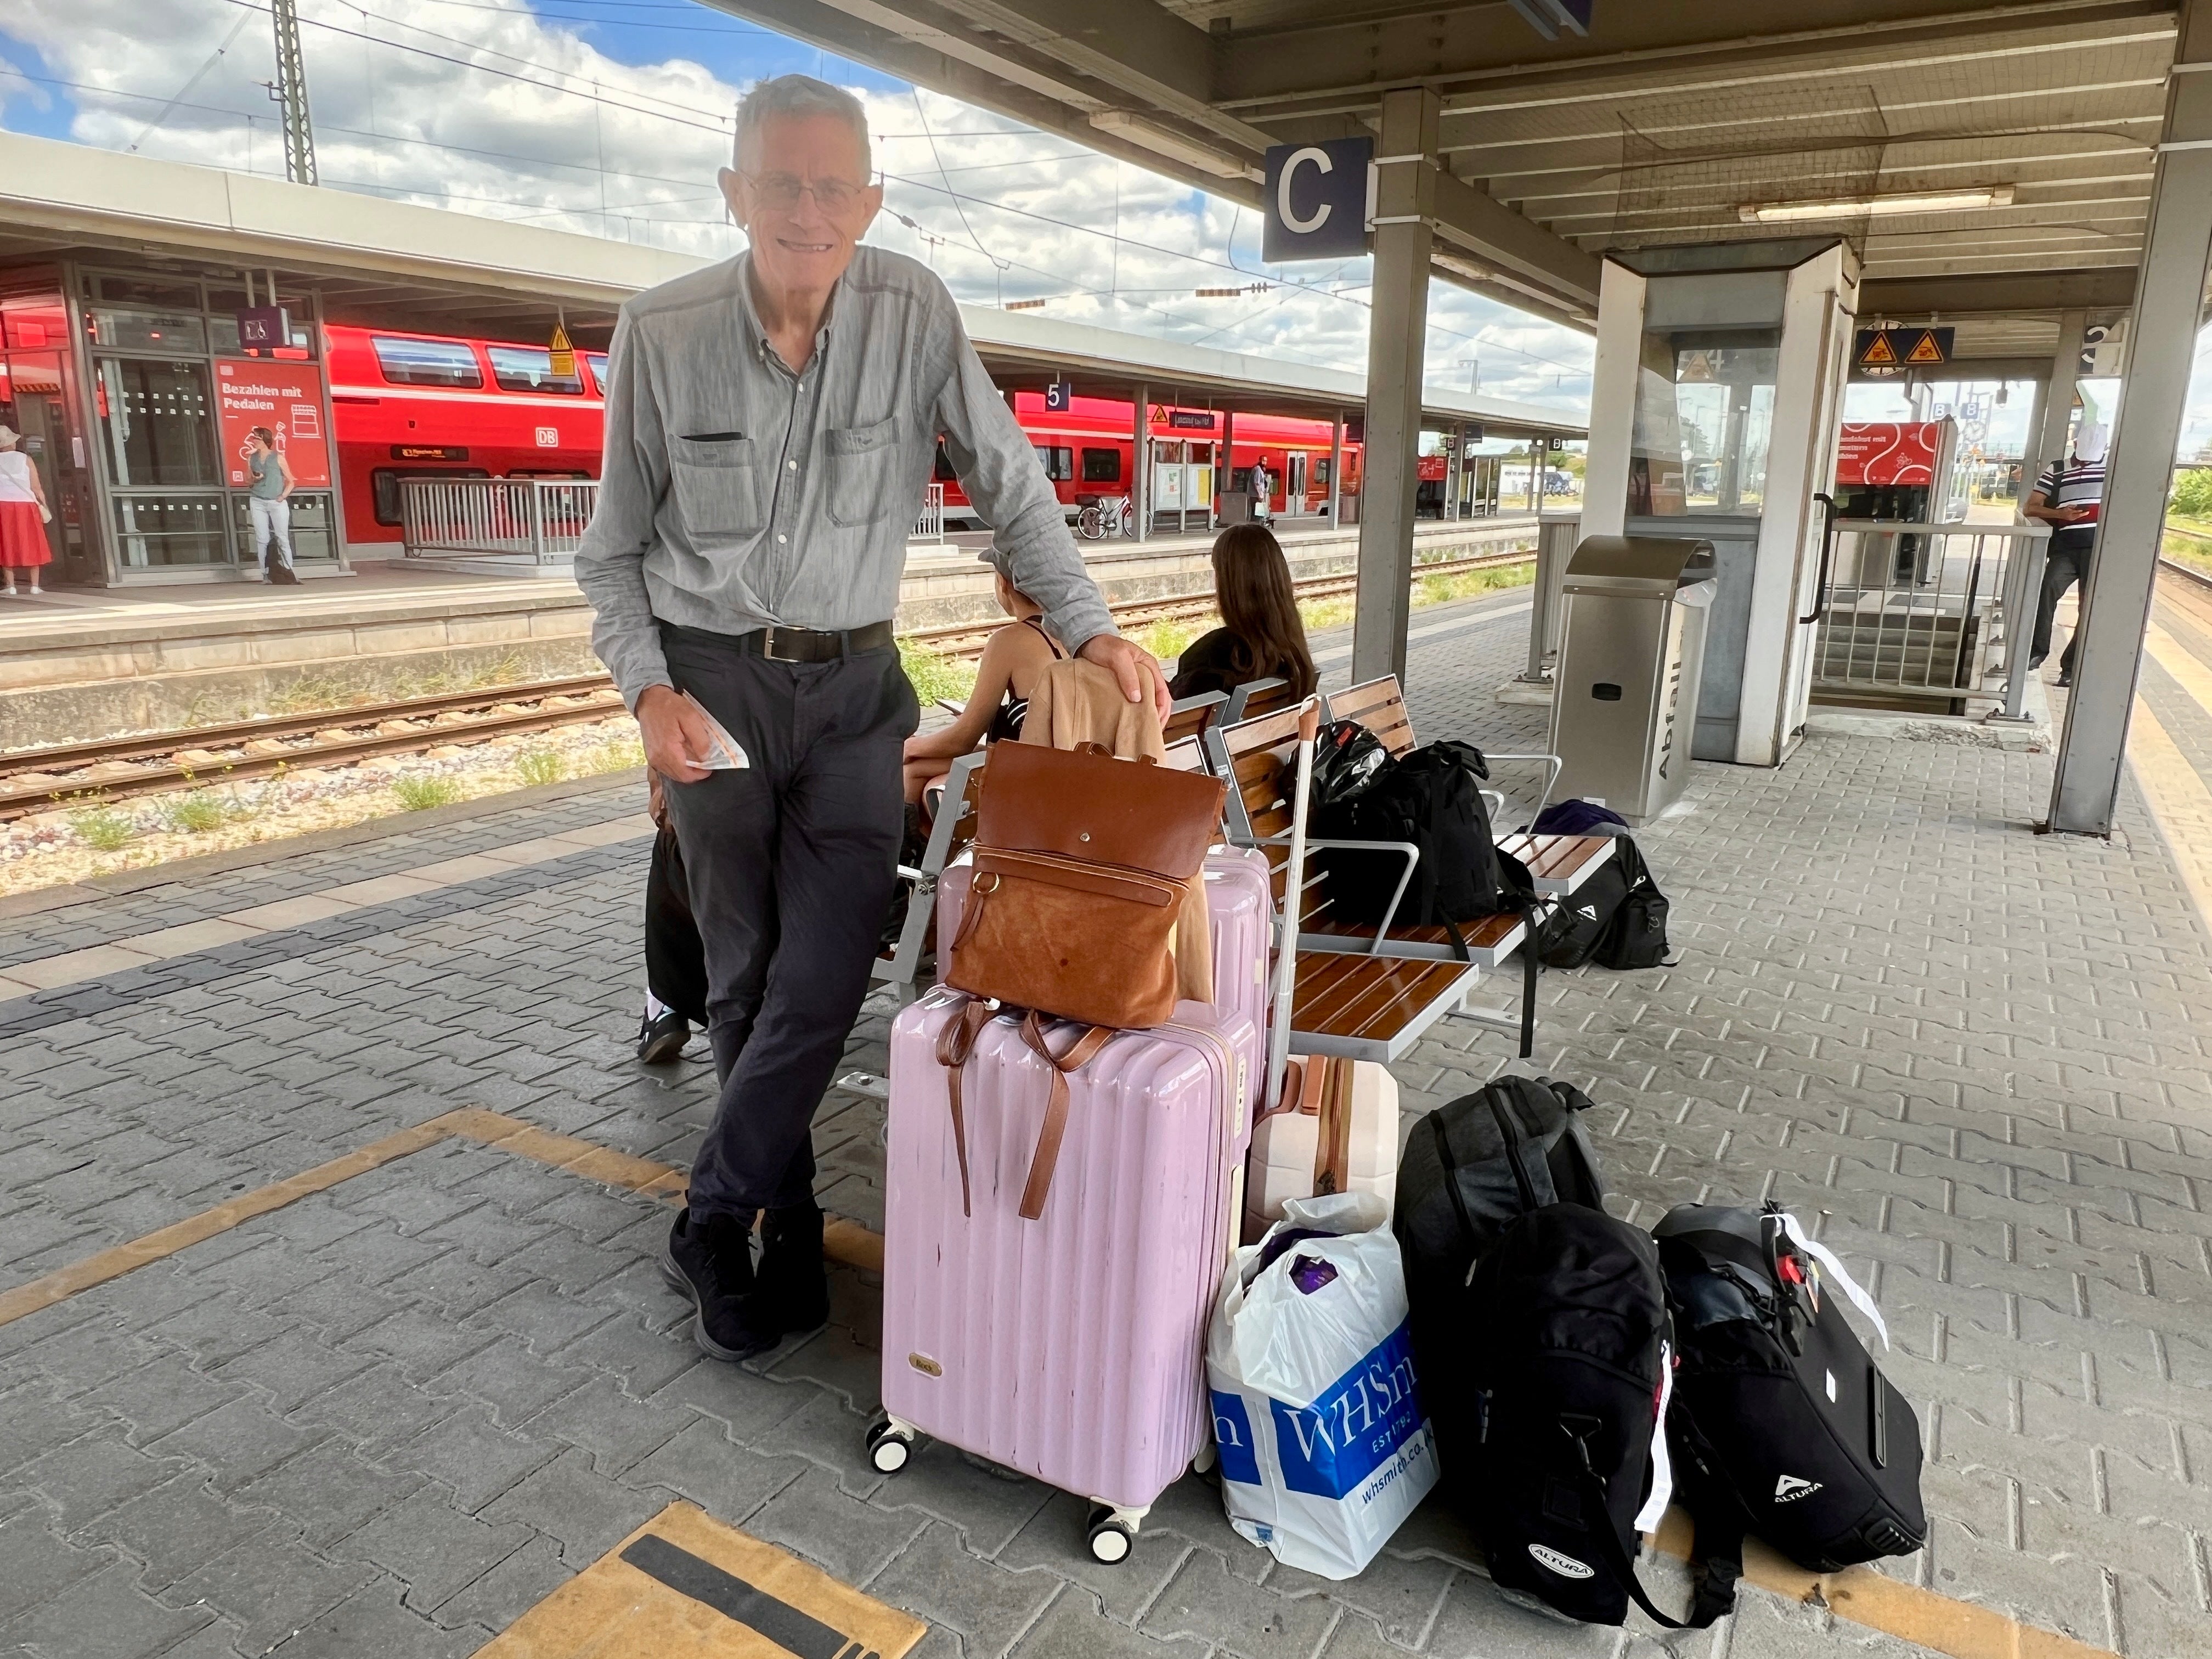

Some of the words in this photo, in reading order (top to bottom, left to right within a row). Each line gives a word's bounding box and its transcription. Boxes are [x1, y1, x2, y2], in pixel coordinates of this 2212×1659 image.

[1278, 147, 1333, 234] C
[222, 382, 279, 396] Bezahlen
[281, 386, 303, 398] mit
[1047, 384, 1060, 407] 5
[223, 397, 275, 410] Pedalen
[1934, 404, 1945, 417] B
[1967, 403, 1977, 416] B
[538, 429, 556, 445] DB
[1372, 1431, 1391, 1453] EST
[1774, 1483, 1823, 1503] ALTURA
[1534, 1549, 1588, 1575] ALTURA
